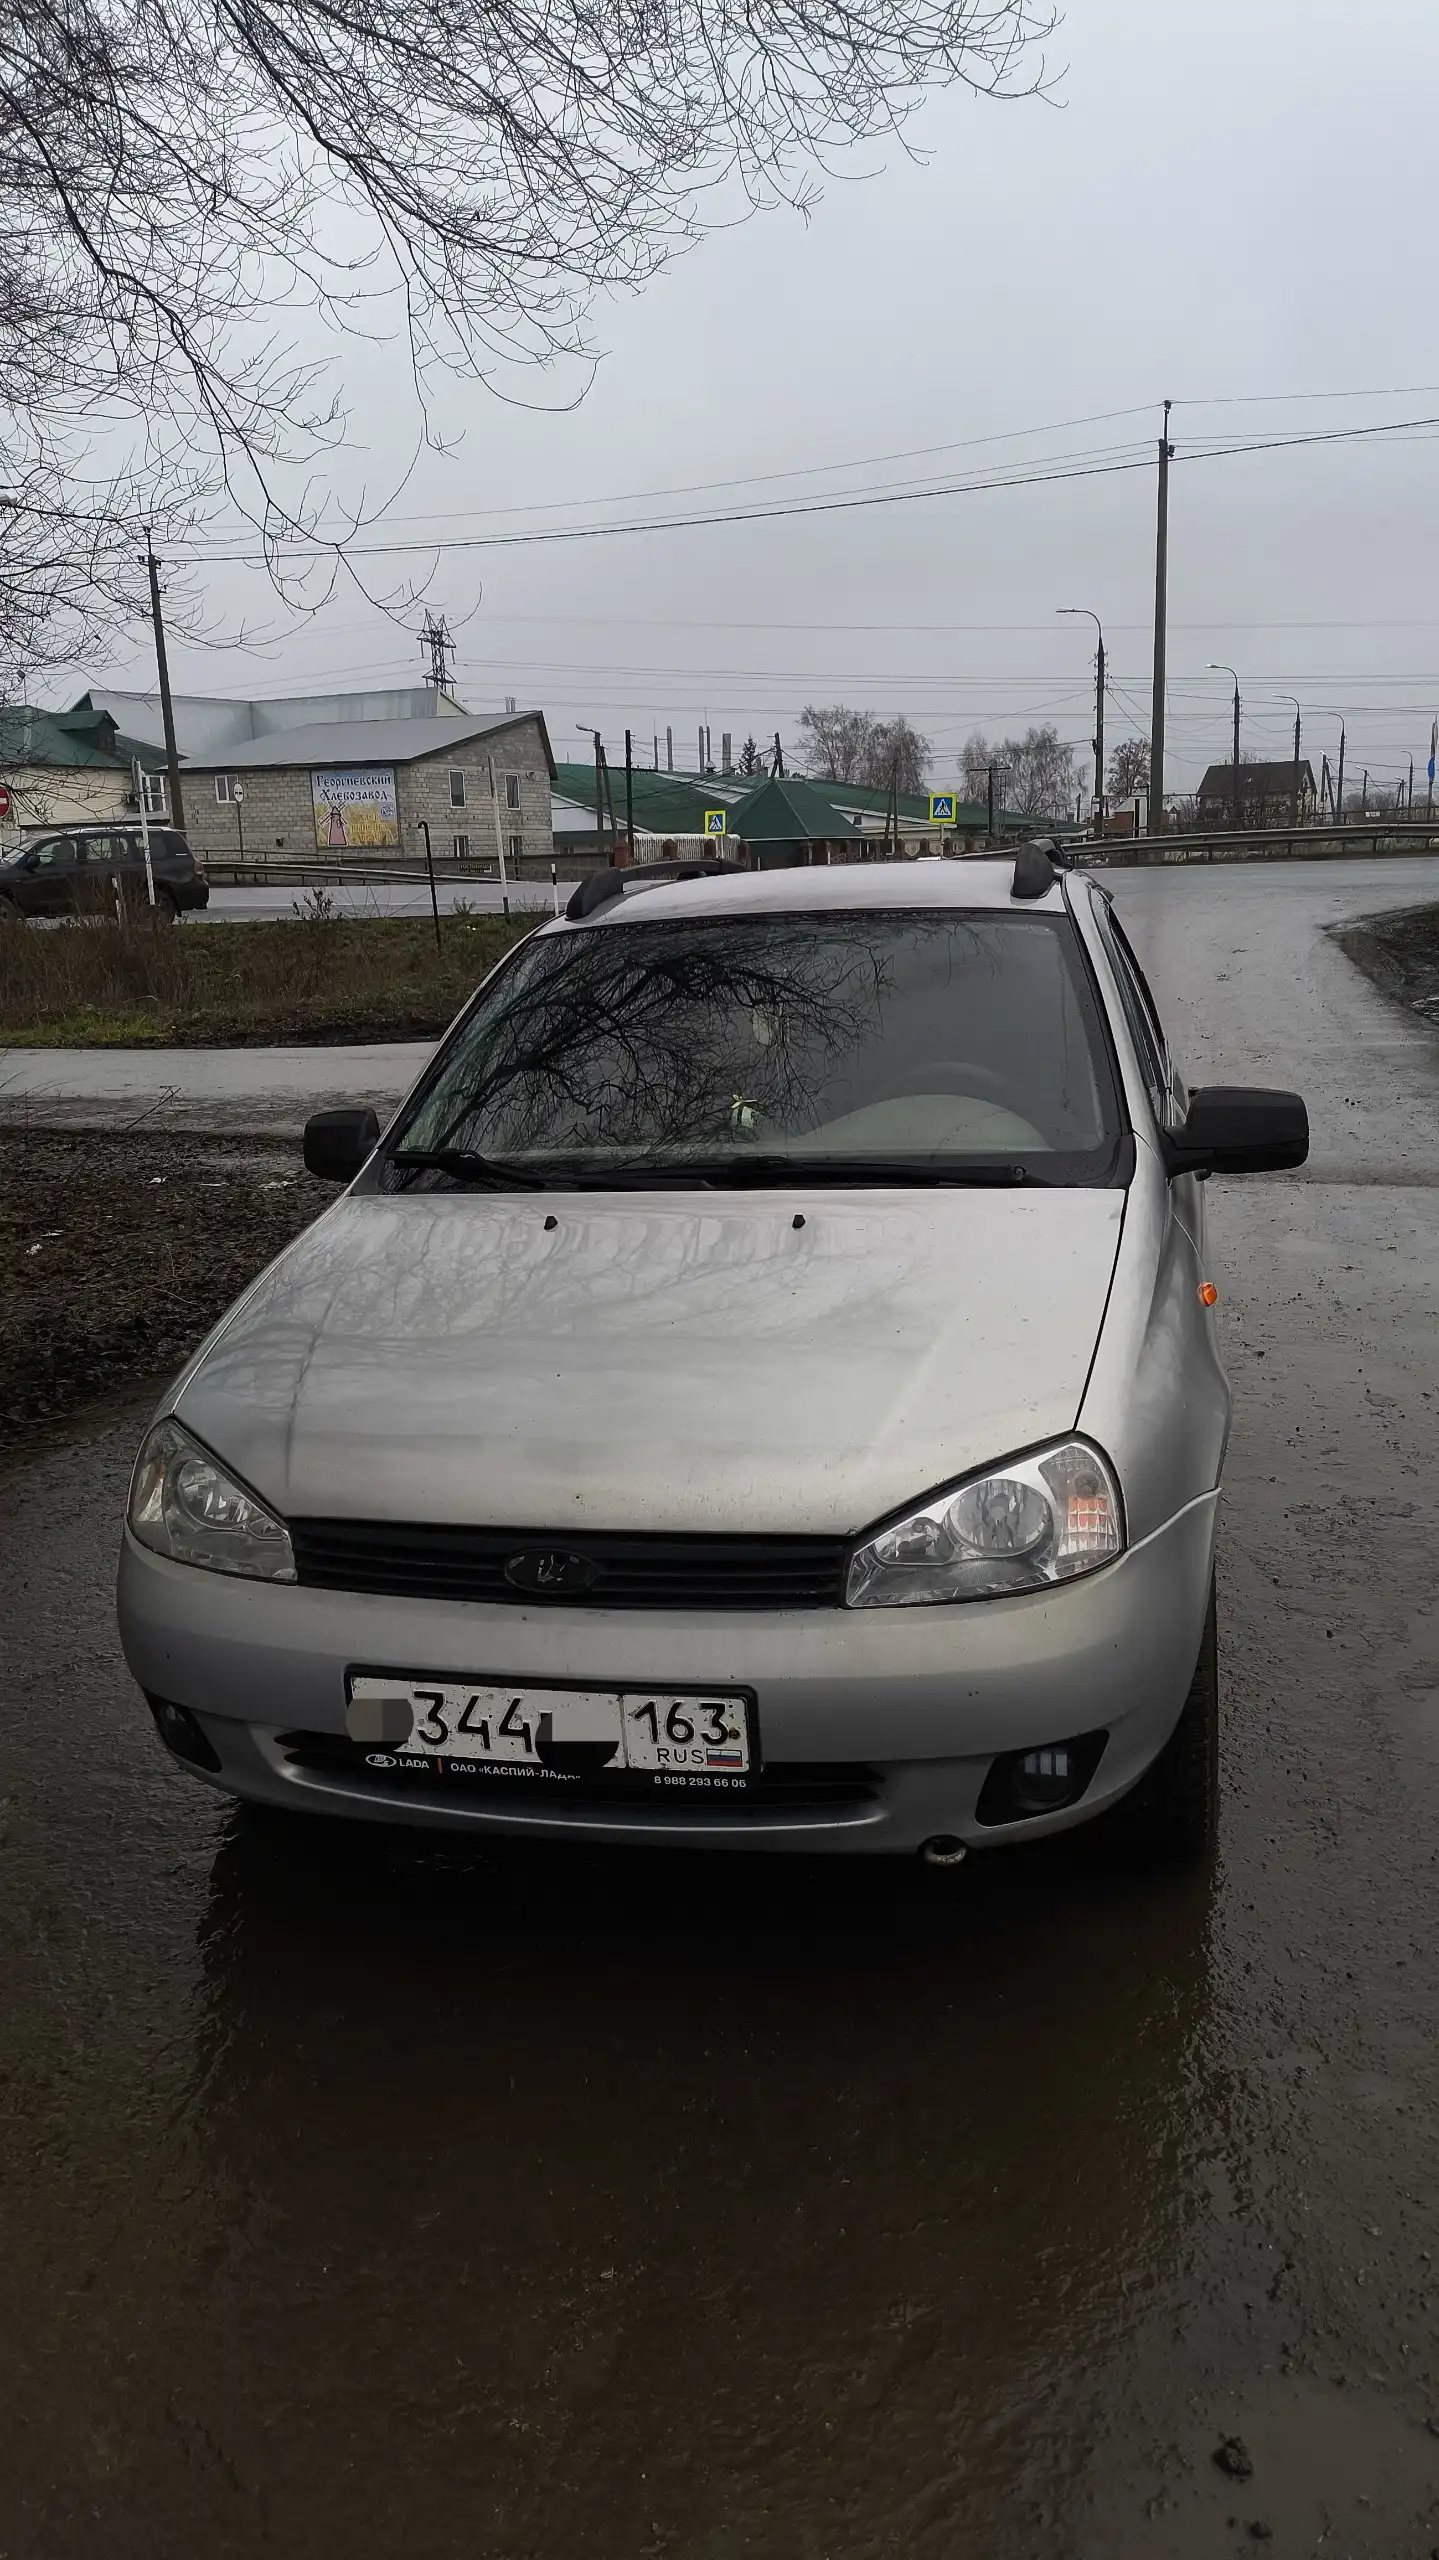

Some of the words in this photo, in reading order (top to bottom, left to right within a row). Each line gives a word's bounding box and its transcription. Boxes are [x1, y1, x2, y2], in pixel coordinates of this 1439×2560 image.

[631, 1700, 730, 1746] 163
[657, 1747, 705, 1764] RUS
[398, 1758, 430, 1769] LADA
[450, 1763, 476, 1773] ОАО
[653, 1775, 662, 1784] 8
[664, 1776, 687, 1786] 988
[689, 1777, 712, 1787] 293
[713, 1778, 729, 1788] 66
